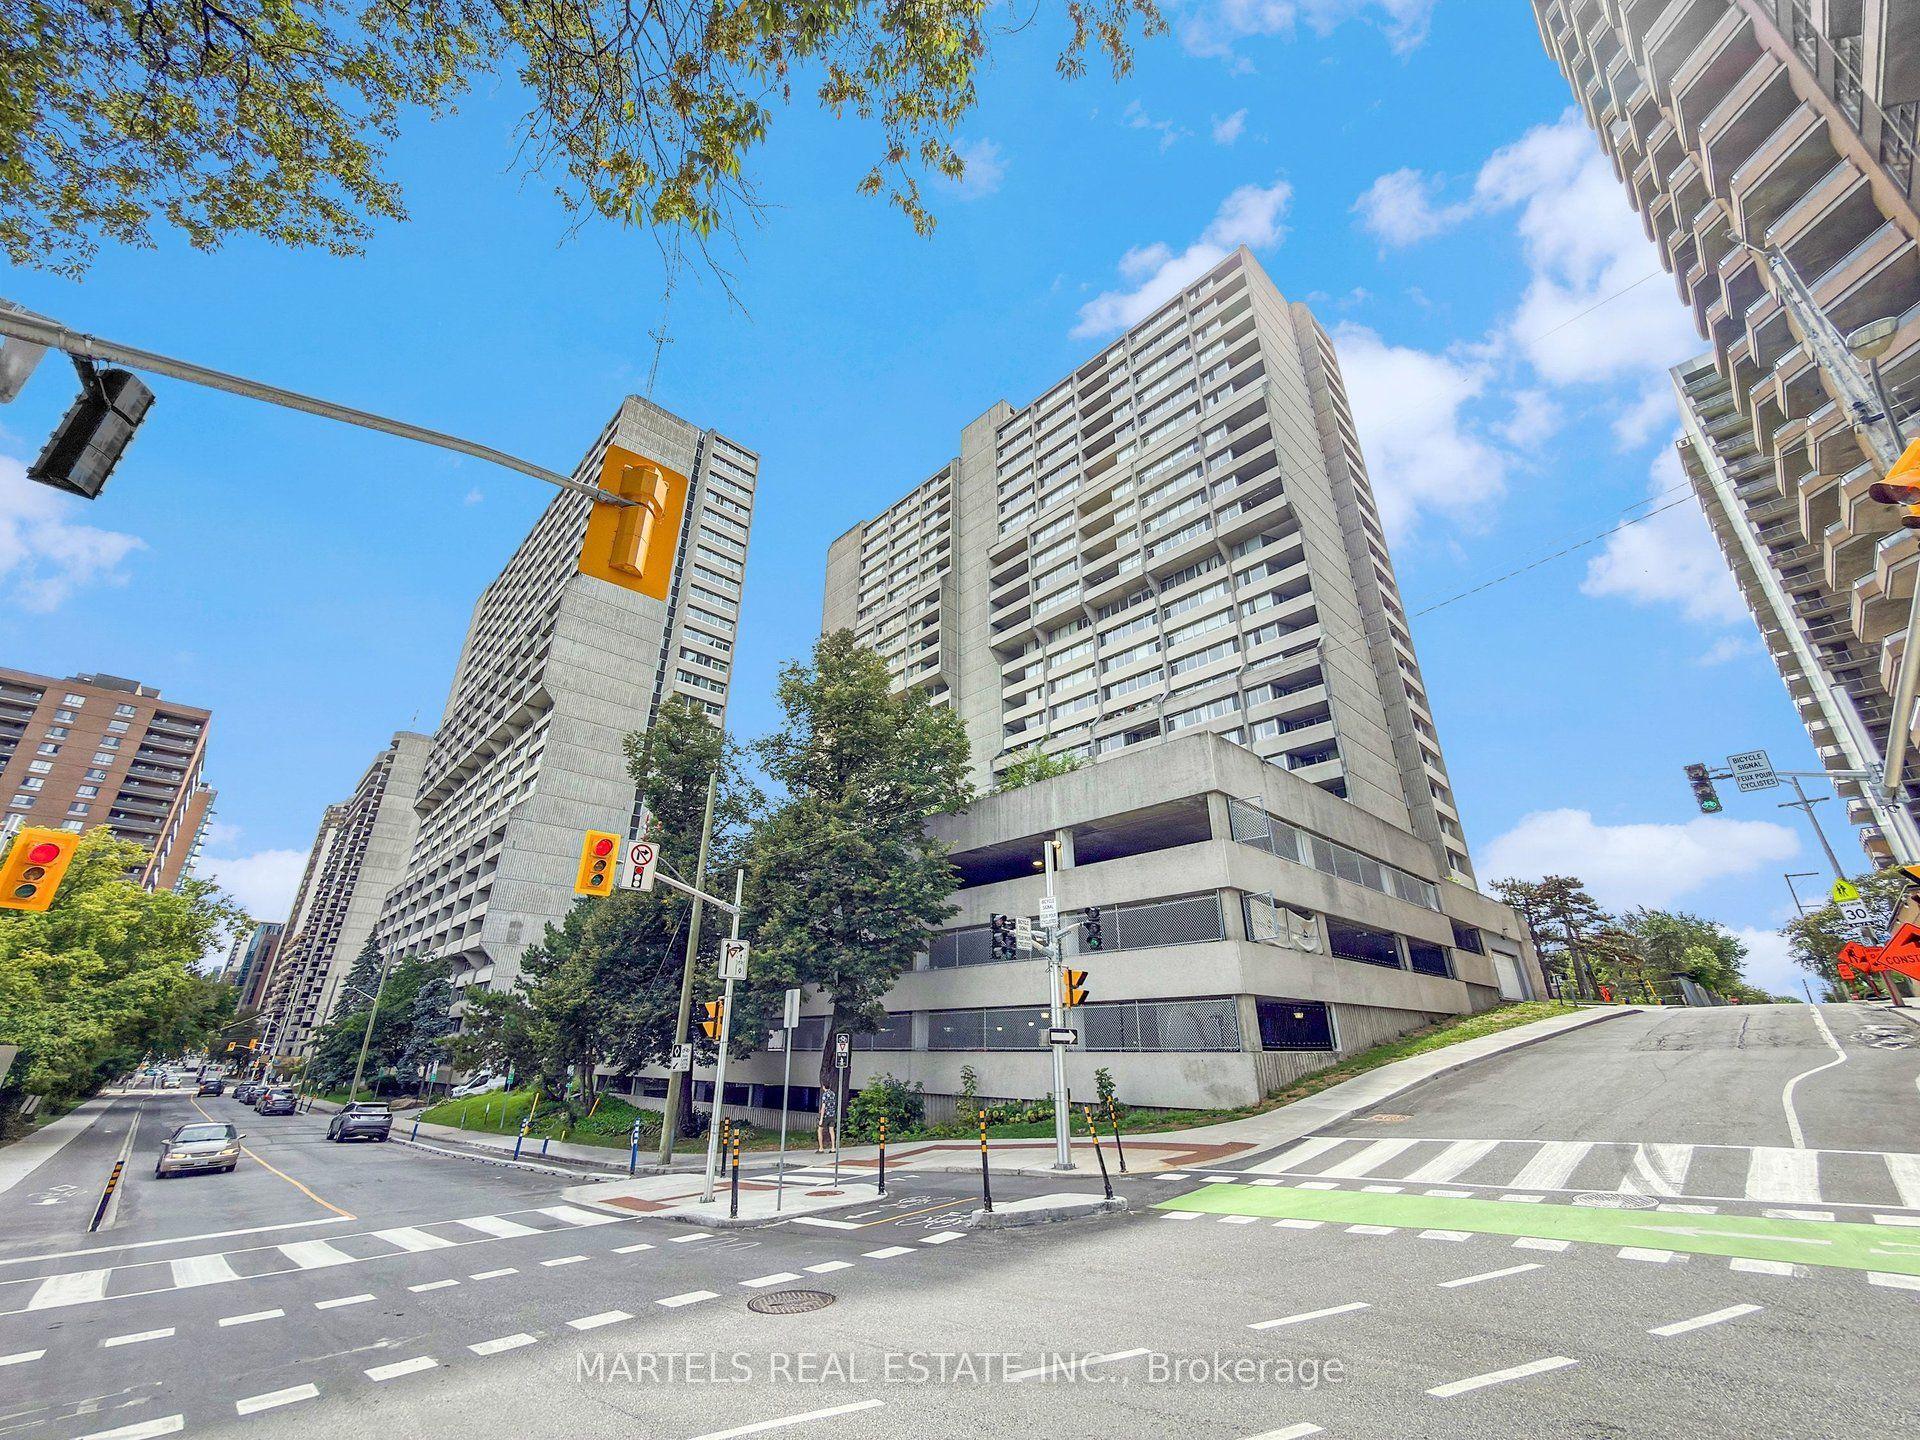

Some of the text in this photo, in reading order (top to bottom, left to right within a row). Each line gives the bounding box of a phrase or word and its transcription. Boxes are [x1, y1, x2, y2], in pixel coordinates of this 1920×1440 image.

[1732, 753, 1762, 764] BICYCLE
[1738, 761, 1764, 771] SIGNAL
[1755, 771, 1773, 780] POUR
[1741, 779, 1776, 790] CYCLISTES
[1846, 908, 1867, 921] 30
[1885, 954, 1920, 965] CONST
